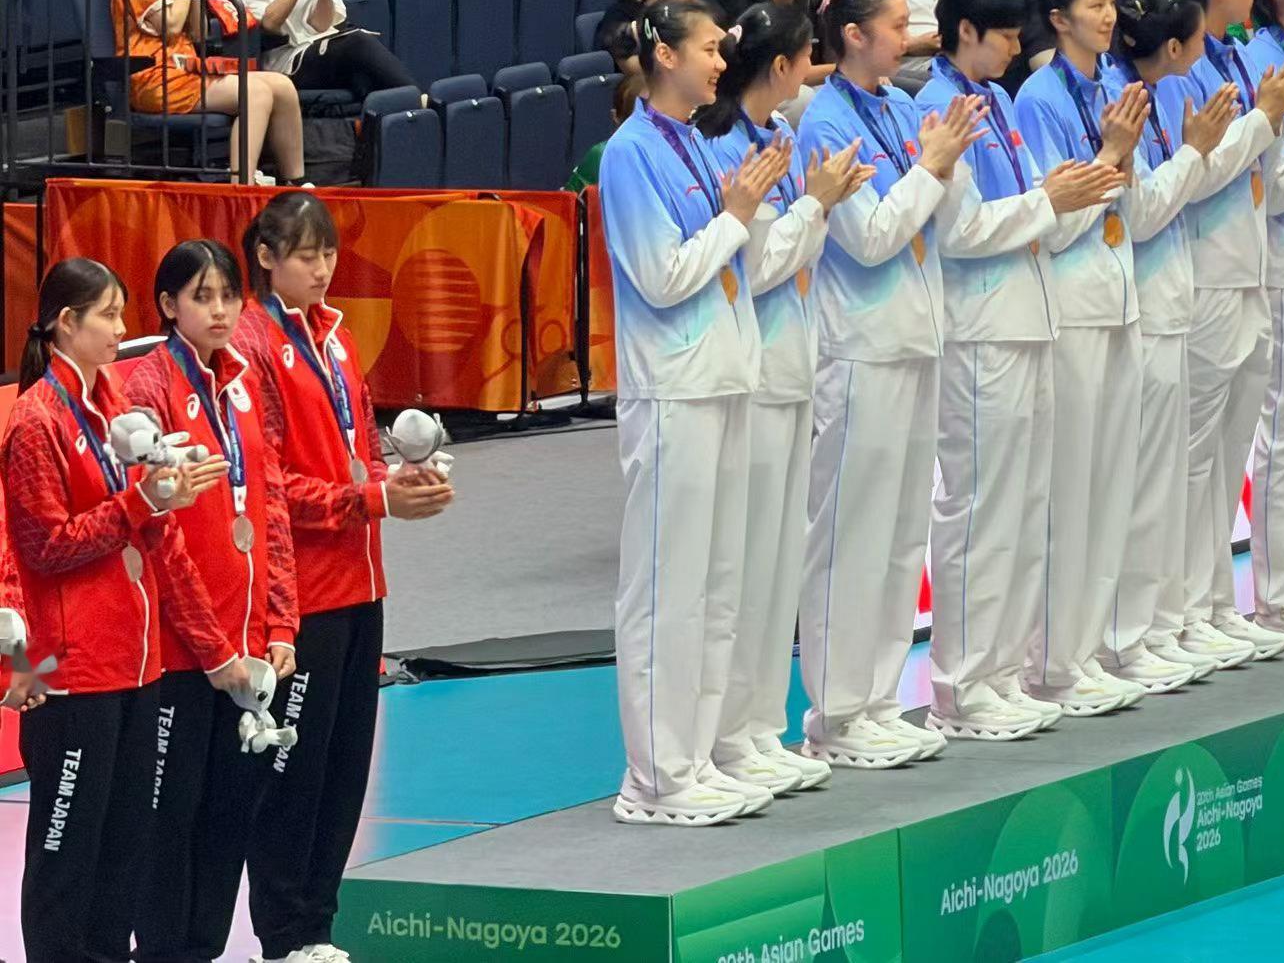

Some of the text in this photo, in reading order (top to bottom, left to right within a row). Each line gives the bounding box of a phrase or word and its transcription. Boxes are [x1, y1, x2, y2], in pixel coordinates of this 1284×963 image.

[157, 706, 175, 754] TEAM
[273, 671, 310, 773] TEAM JPAN
[44, 748, 82, 852] TEAM JAPAN
[1197, 794, 1263, 829] Aichi-Nagoya
[1196, 826, 1221, 852] 2026
[941, 849, 1079, 915] Aichi-Nagoya 2026
[367, 908, 621, 950] Aichi-Nagoya 2026
[807, 919, 864, 955] Games
